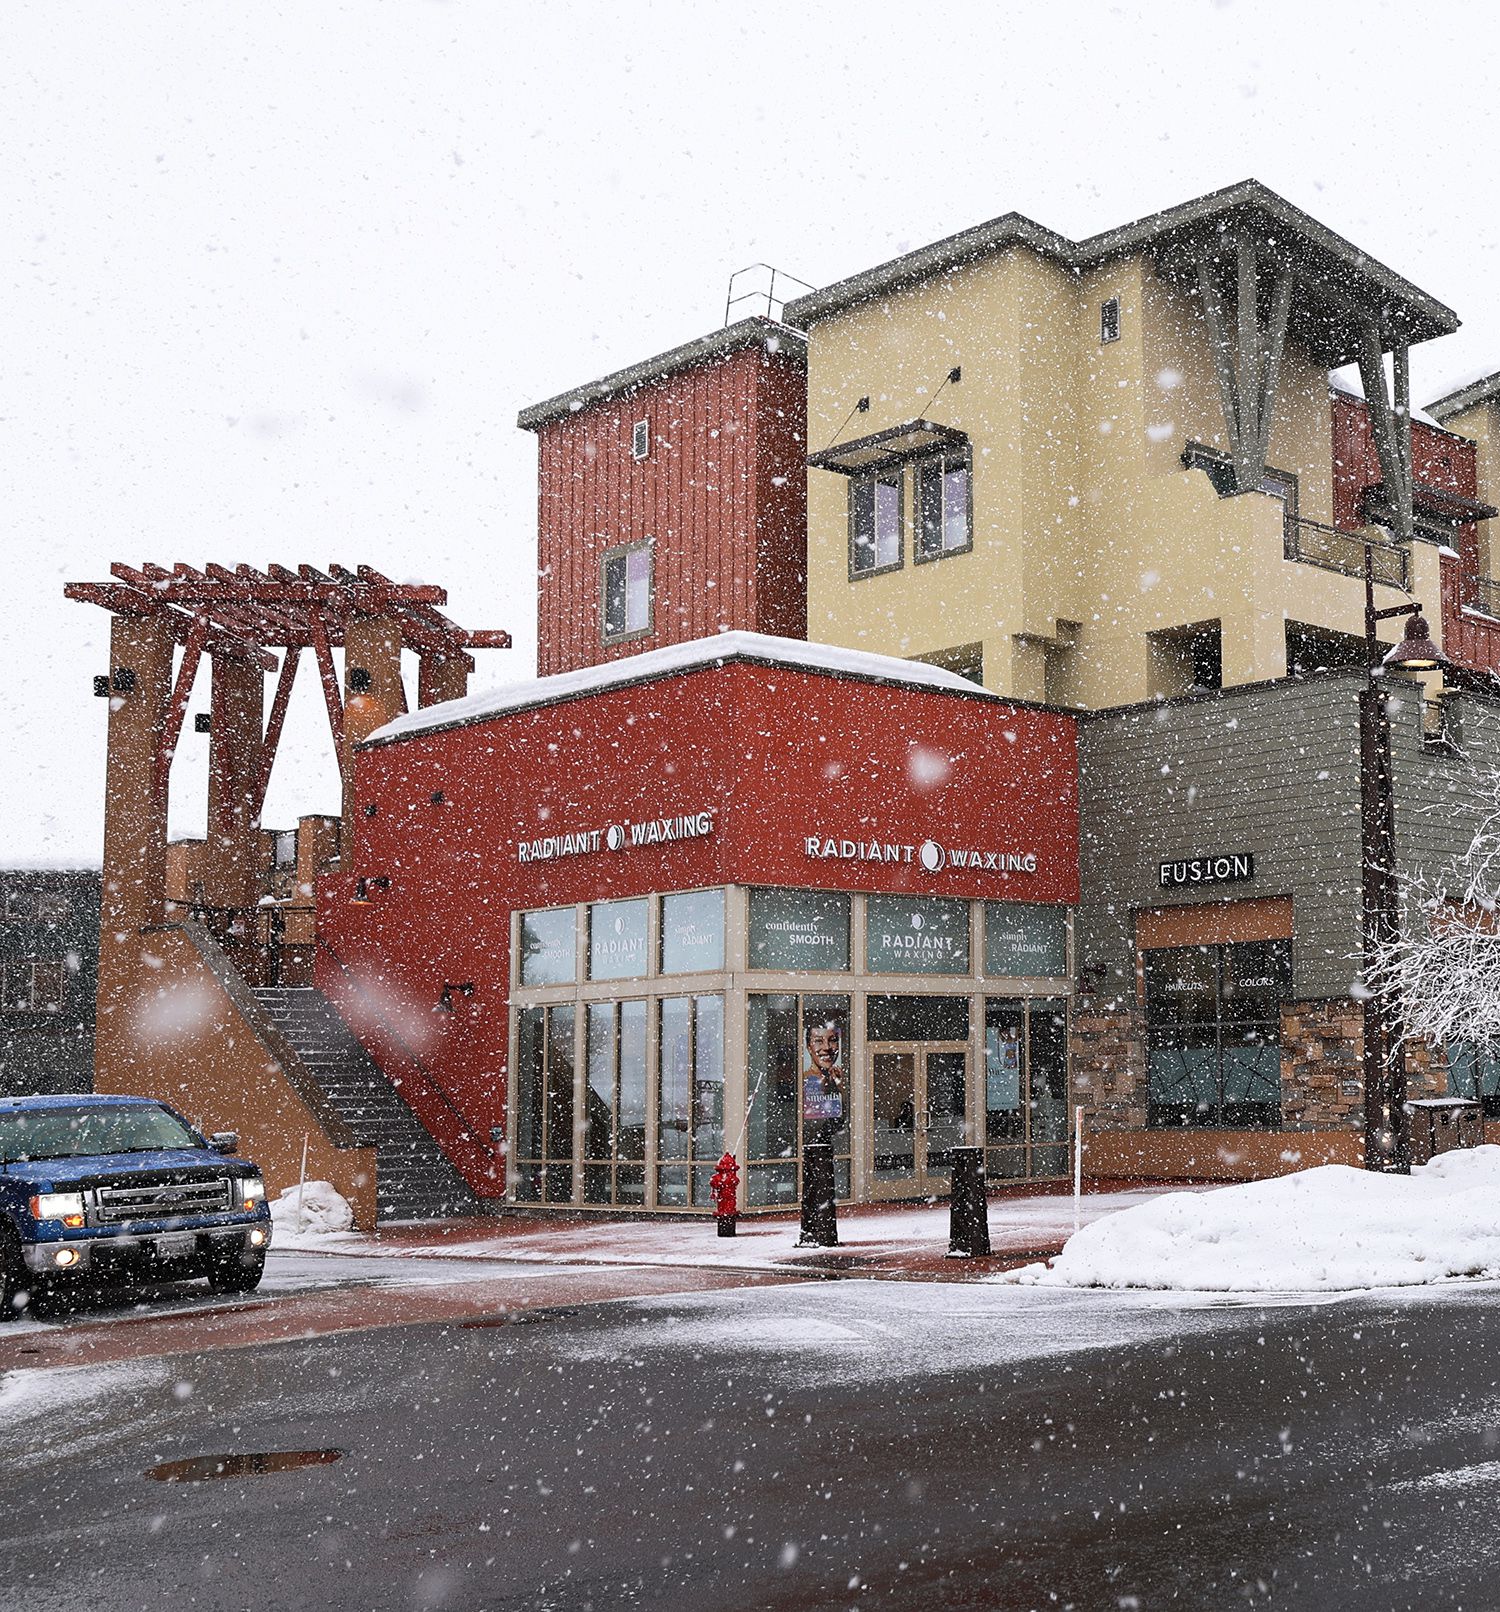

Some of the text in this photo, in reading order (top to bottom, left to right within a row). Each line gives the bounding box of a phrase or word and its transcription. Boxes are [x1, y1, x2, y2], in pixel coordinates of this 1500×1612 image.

[518, 811, 713, 863] RADIANT WAXING
[804, 836, 1037, 872] RADIANT WAXING
[1160, 855, 1248, 884] FUSION
[765, 921, 819, 934] confidently
[594, 938, 644, 955] RADIANT
[789, 934, 834, 945] SMOOTH
[882, 934, 952, 950] RADIANT
[894, 950, 943, 959] WAXING
[1011, 943, 1048, 953] RADIANT
[1239, 977, 1275, 987] COLORS
